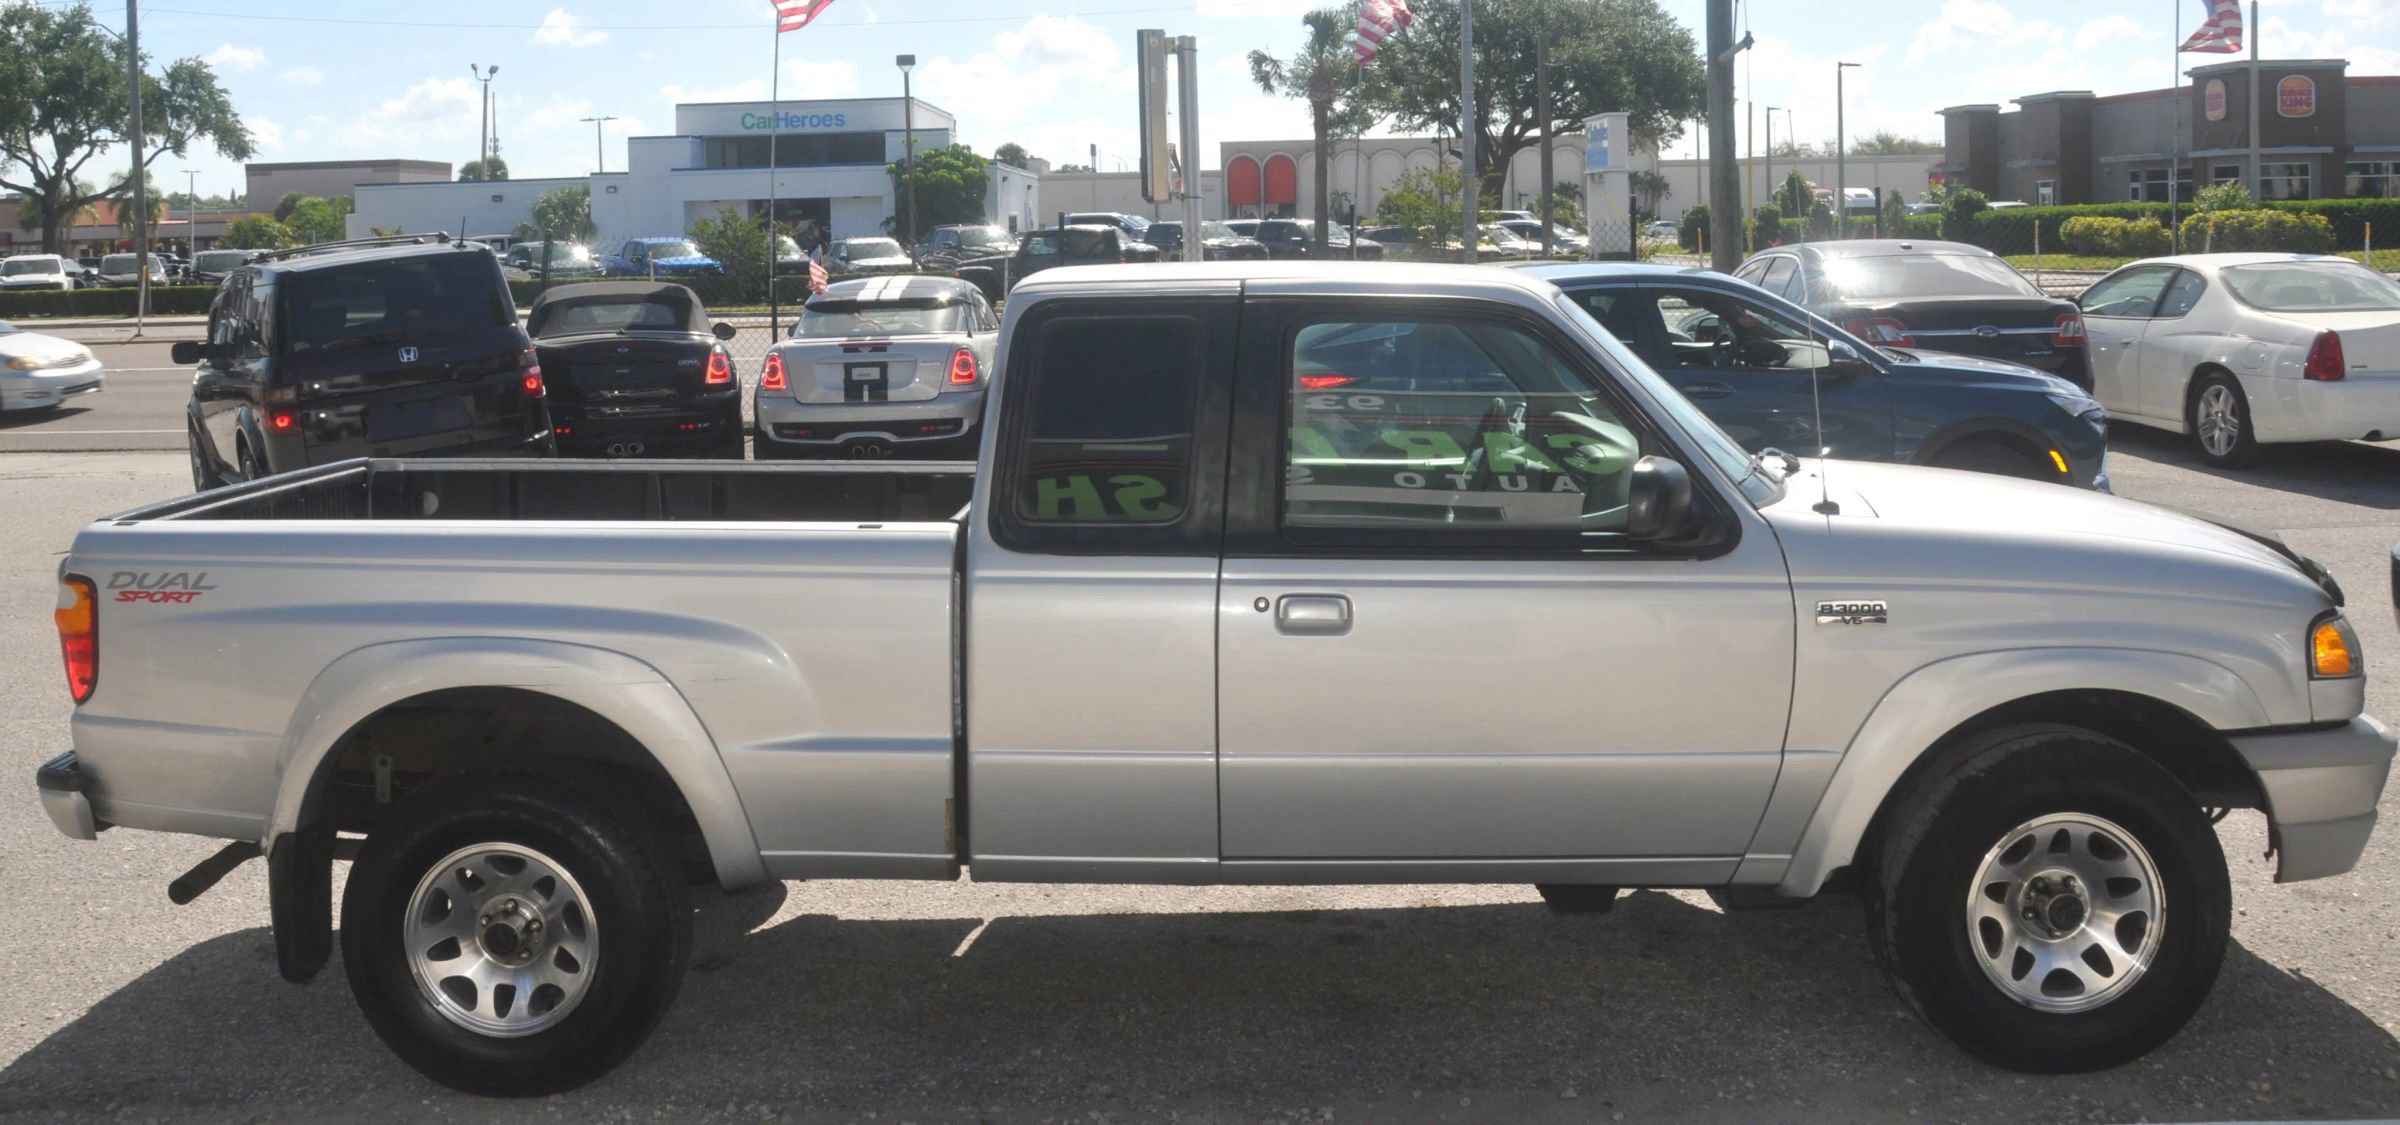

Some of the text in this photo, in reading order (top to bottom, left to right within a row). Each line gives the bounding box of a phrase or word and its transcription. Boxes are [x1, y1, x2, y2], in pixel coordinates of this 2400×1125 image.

[741, 111, 846, 130] CarHeroes
[107, 571, 218, 590] DUAL
[114, 591, 203, 603] SPORT
[1820, 604, 1884, 615] B3000
[1841, 616, 1864, 625] V6
